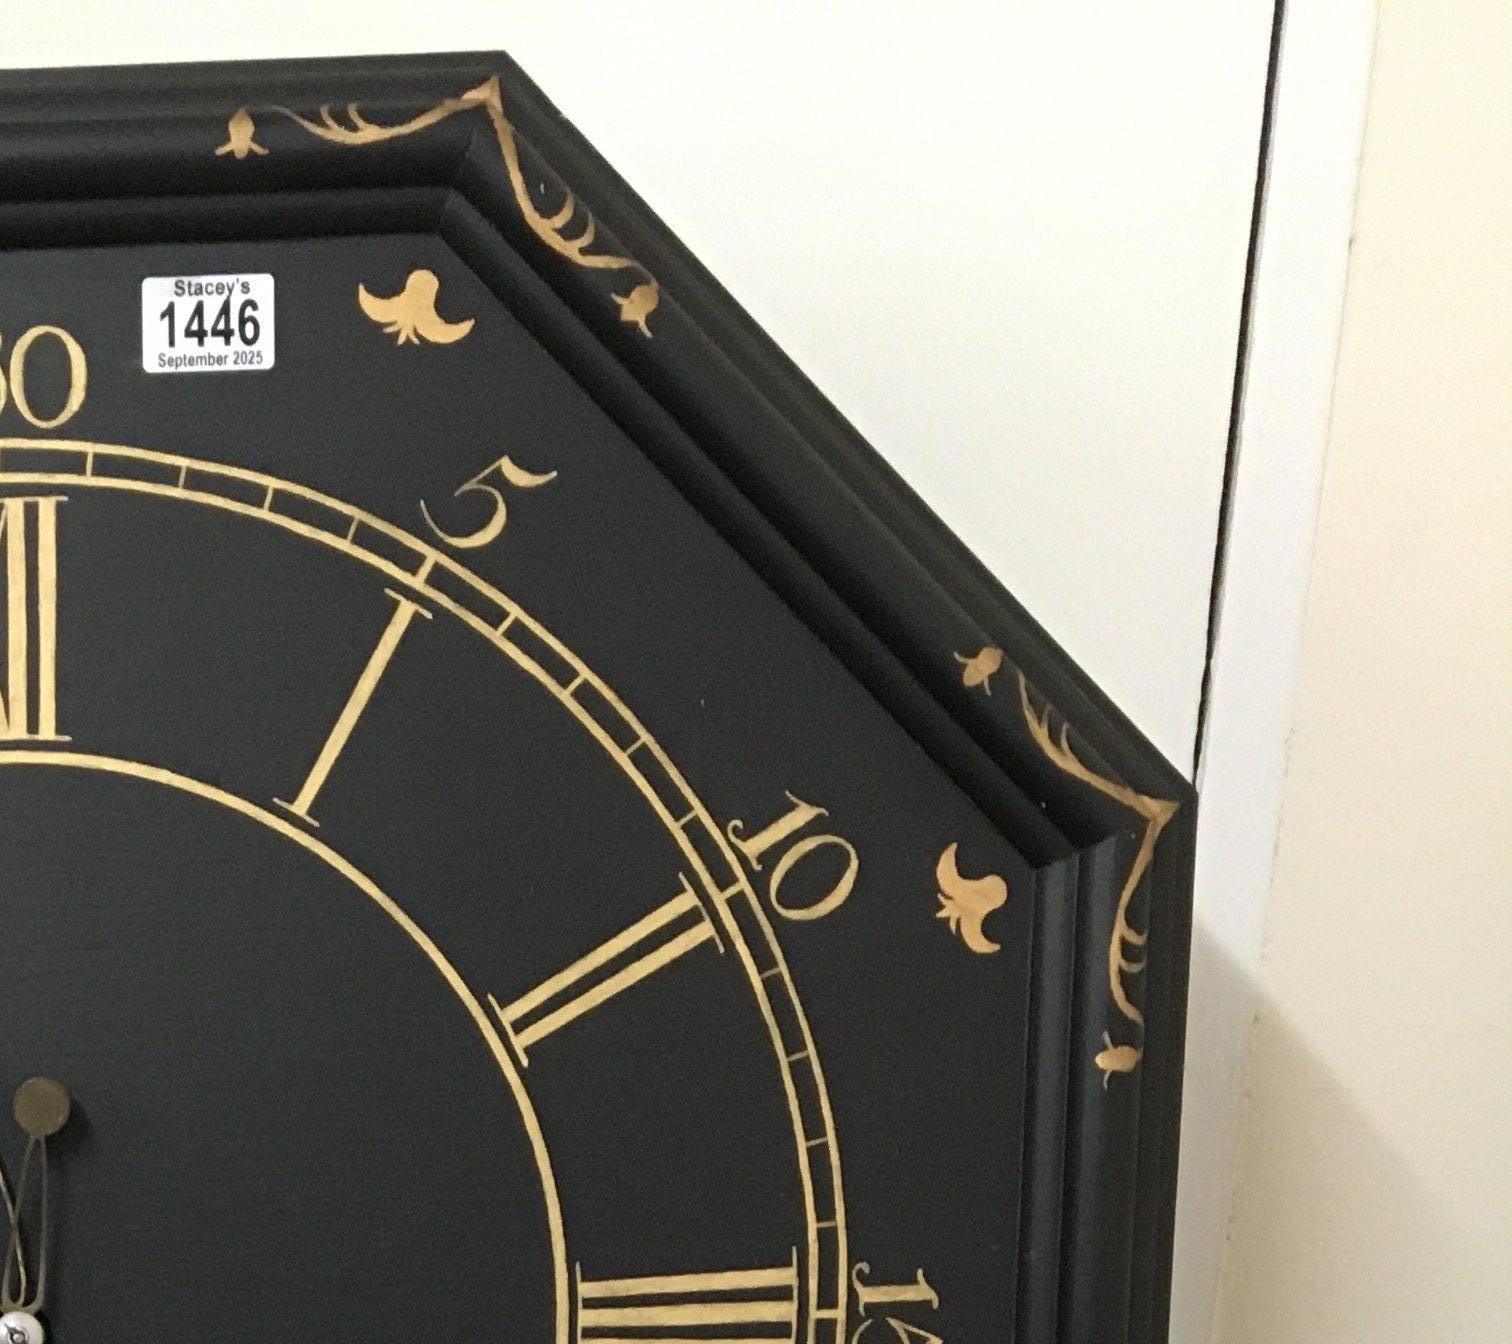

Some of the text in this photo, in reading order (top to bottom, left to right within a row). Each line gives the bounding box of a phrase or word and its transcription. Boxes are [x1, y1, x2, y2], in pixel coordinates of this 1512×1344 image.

[174, 278, 250, 297] Stacey's
[159, 299, 260, 348] 1446
[158, 350, 263, 370] September 2025
[421, 455, 557, 548] 5
[727, 791, 859, 920] 10
[488, 872, 724, 1067] II
